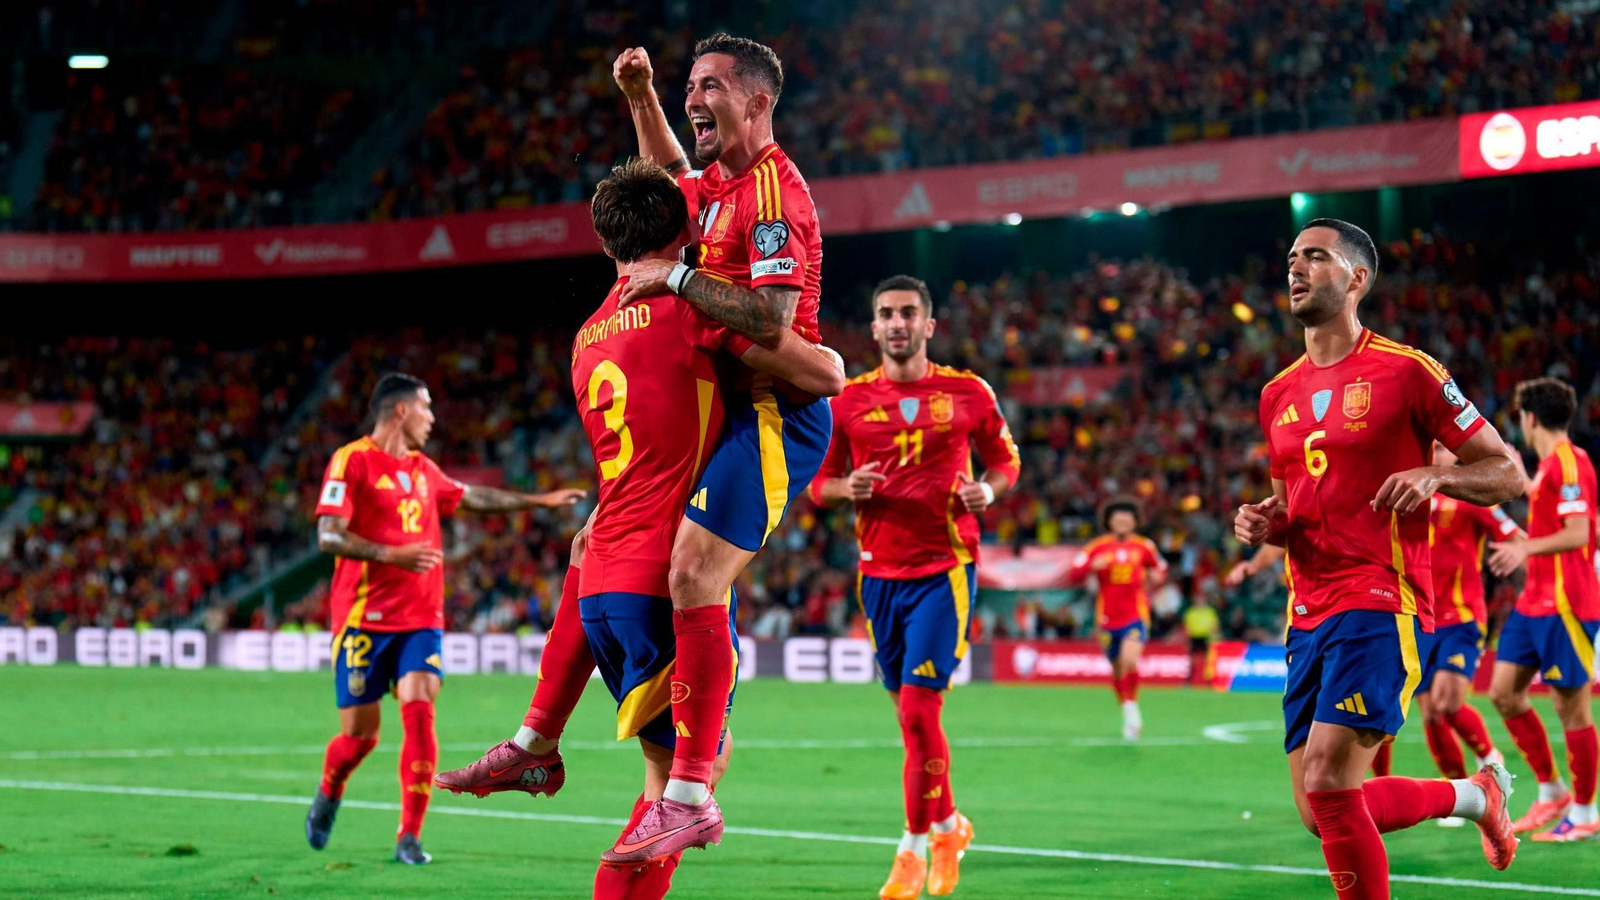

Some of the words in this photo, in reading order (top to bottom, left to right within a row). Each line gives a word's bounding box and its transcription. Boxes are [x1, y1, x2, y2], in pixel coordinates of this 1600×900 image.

[1536, 114, 1600, 159] ESP
[577, 303, 651, 352] NORMAND
[588, 359, 634, 481] 3
[893, 428, 924, 467] 11
[1303, 430, 1329, 478] 6
[397, 498, 423, 533] 12
[342, 634, 373, 668] 12
